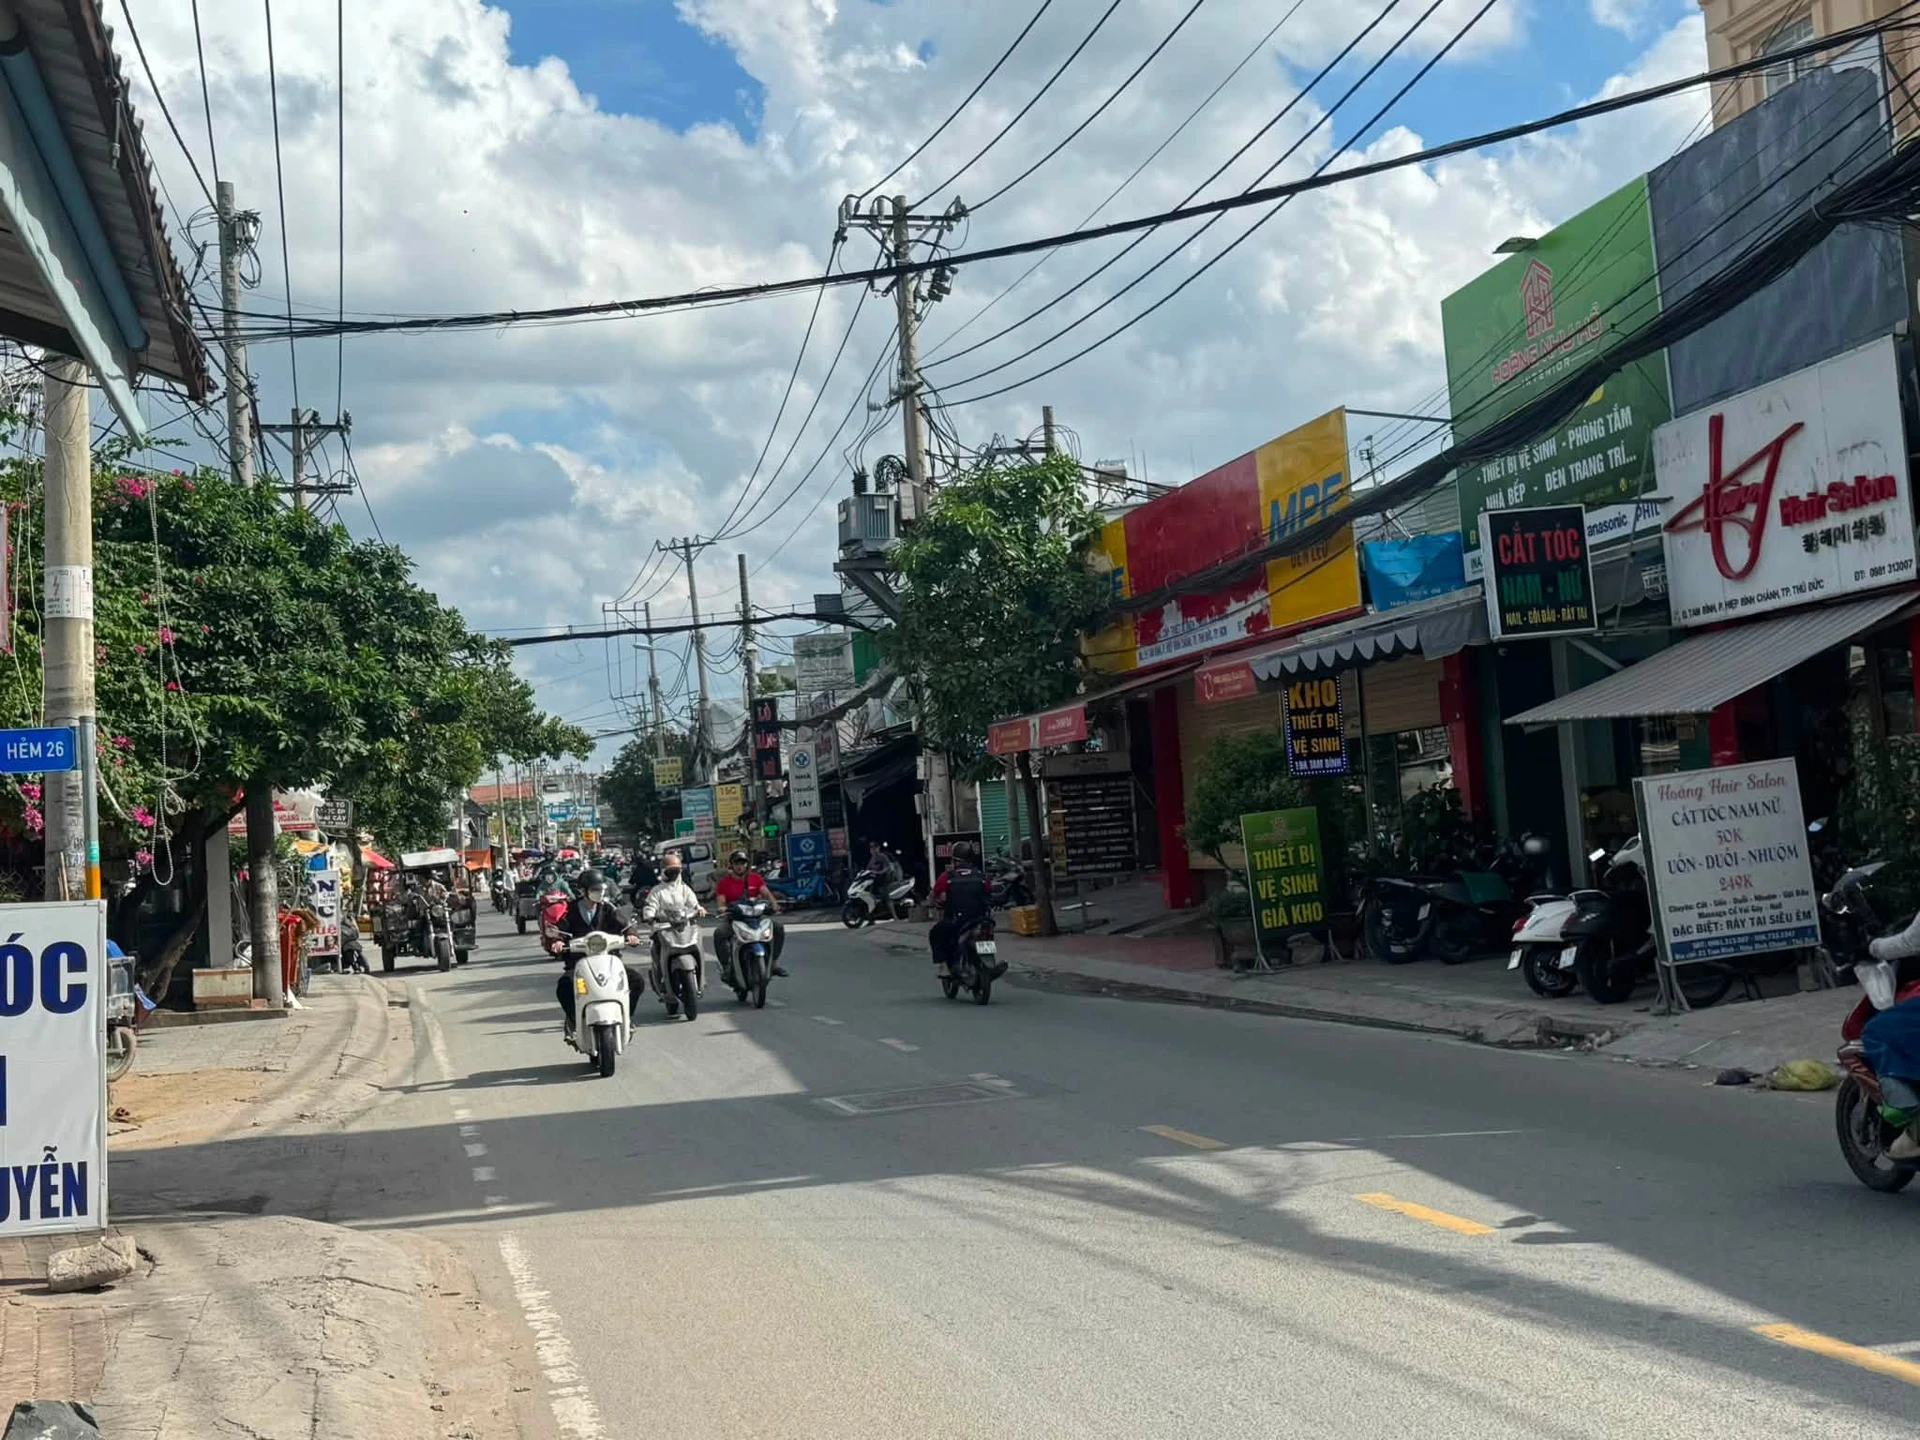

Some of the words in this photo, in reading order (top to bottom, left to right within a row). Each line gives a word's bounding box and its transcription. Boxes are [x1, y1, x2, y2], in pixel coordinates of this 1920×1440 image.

[1481, 453, 1506, 484] THIẾT
[1507, 446, 1519, 476] BỊ
[1518, 444, 1532, 472] VỆ
[1532, 435, 1558, 465] SINH
[1567, 419, 1606, 450] PHÒNG
[1607, 402, 1633, 433] TẮM
[1486, 487, 1506, 511] NHÀ
[1507, 477, 1526, 506] BẾP
[1545, 466, 1567, 493] ĐÈN
[1569, 453, 1605, 483] TRANG
[1828, 475, 1897, 512] Salon
[1587, 510, 1628, 538] anasonic
[1635, 500, 1661, 522] PHIL
[1499, 521, 1536, 566] CẮT
[1541, 522, 1583, 563] TÓC
[1501, 572, 1543, 608] NAM
[1557, 563, 1583, 603] NỮ
[1289, 678, 1338, 710] KHO
[1291, 709, 1323, 731] THIẾT
[1325, 711, 1339, 730] BỊ
[7, 736, 42, 760] HẺM
[46, 741, 64, 758] 26
[1293, 735, 1309, 757] VỆ
[1311, 737, 1340, 754] SINH
[1709, 776, 1742, 797] Hair
[1747, 772, 1787, 791] Salon
[1671, 804, 1697, 827] CẮT
[1702, 802, 1727, 824] TÓC
[1728, 800, 1761, 820] NAM
[1253, 839, 1295, 871] THIẾT
[1299, 843, 1316, 868] BỊ
[1257, 874, 1277, 903] VỆ
[1280, 872, 1320, 897] SINH
[1261, 901, 1289, 930] GIÁ
[1290, 901, 1325, 926] KHO
[1672, 922, 1695, 939] ĐẶC
[1726, 914, 1748, 932] RÁY
[1749, 915, 1767, 928] TAI
[1769, 909, 1793, 925] SIÊU
